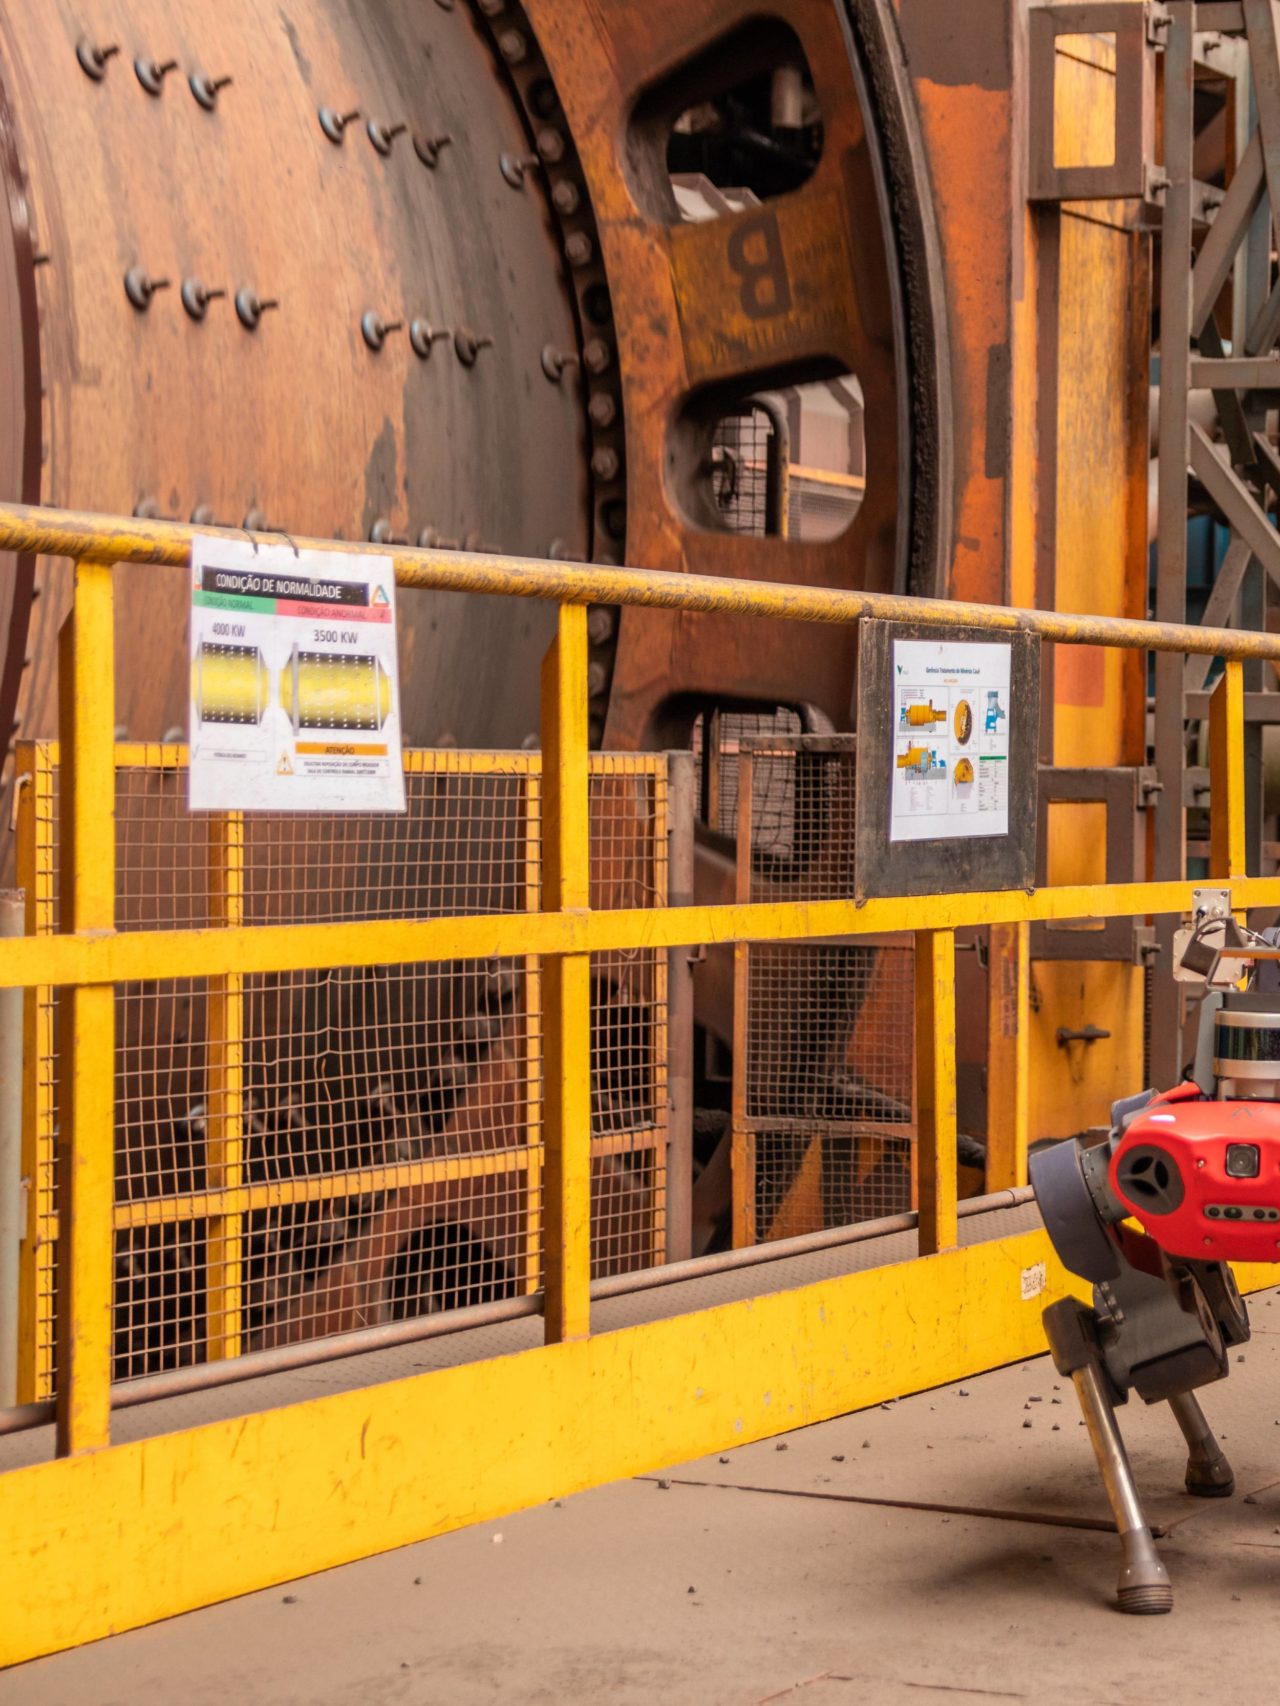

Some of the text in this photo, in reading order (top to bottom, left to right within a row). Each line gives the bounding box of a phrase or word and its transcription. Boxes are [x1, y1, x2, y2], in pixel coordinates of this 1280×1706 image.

[216, 573, 343, 599] CONDIÇÃO DE NORMALIDADE
[202, 595, 227, 608] NDIÇÃO
[212, 621, 246, 637] 4000 KW
[313, 629, 358, 644] 3500 KW
[324, 745, 355, 756] ATENÇÃO
